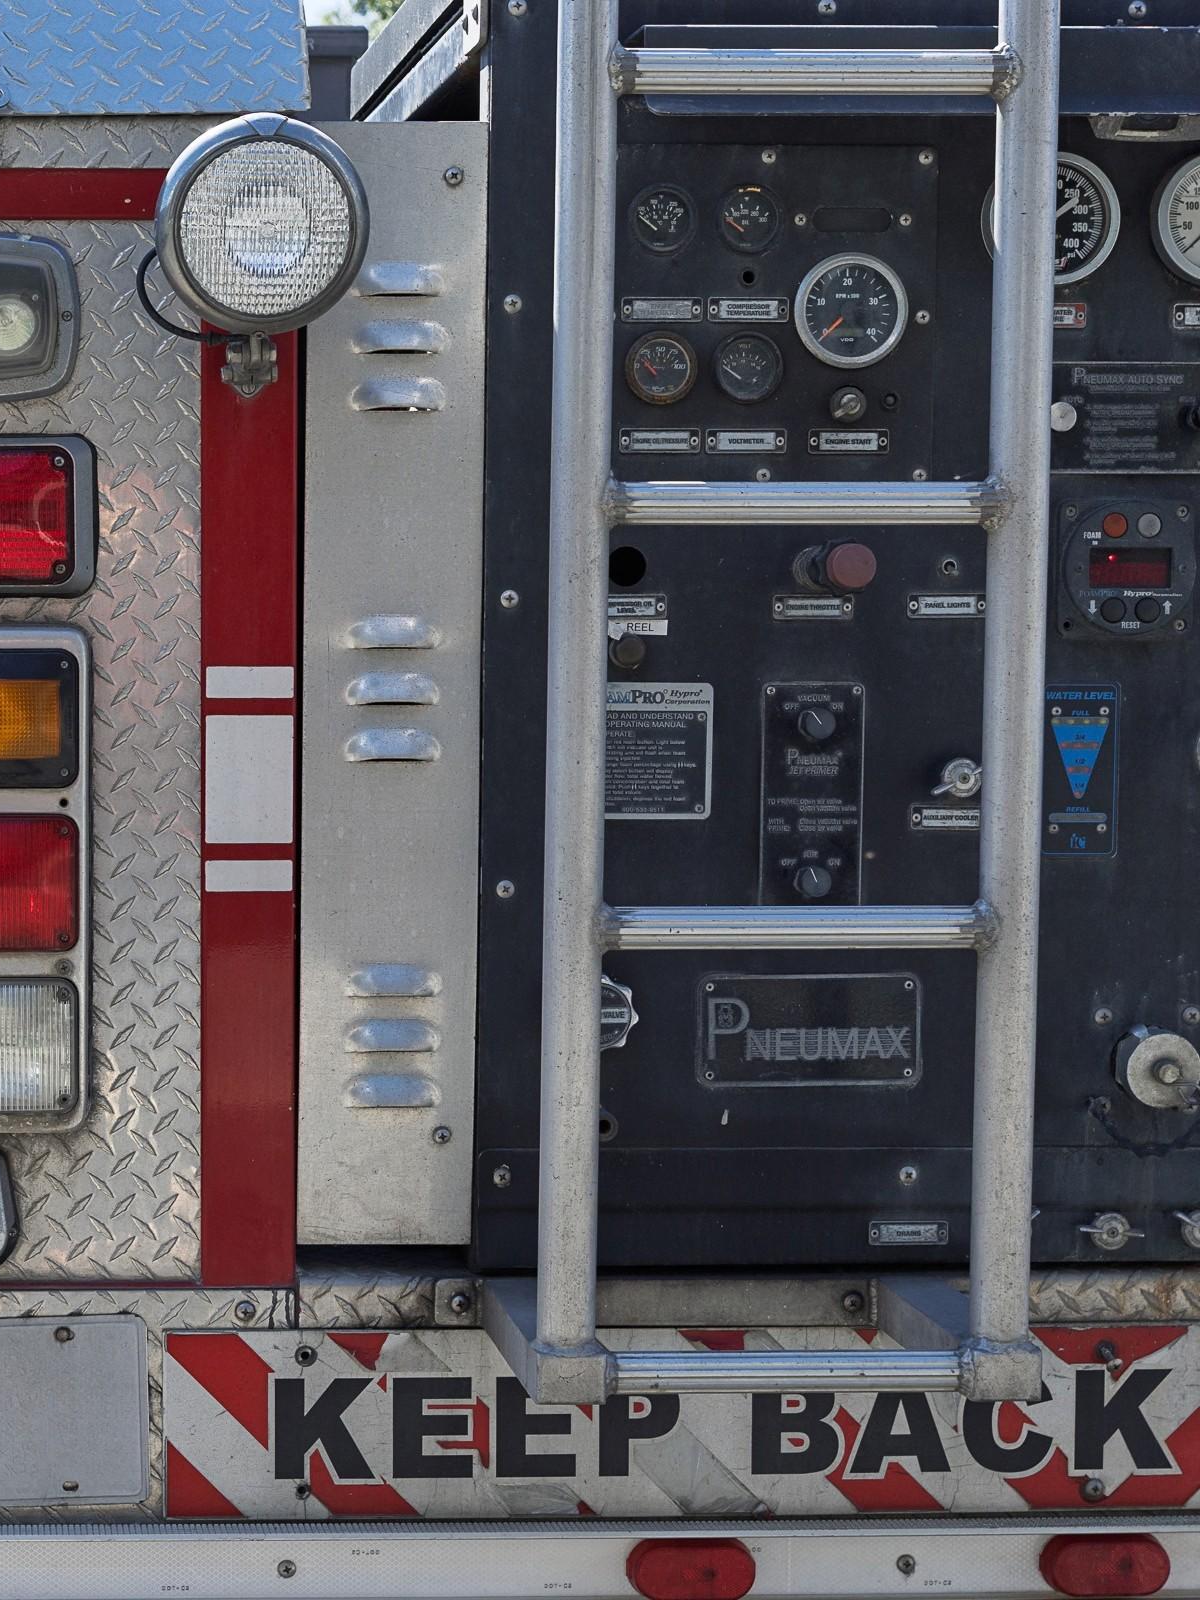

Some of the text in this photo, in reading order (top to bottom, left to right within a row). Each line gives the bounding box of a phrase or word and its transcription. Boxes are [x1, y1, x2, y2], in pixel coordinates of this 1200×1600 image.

[1064, 188, 1080, 198] 250
[1072, 205, 1088, 214] 300
[1185, 201, 1199, 210] 100
[1072, 222, 1088, 232] 350
[1183, 221, 1192, 230] 50
[1063, 238, 1079, 248] 400
[1073, 368, 1184, 385] PNEUMAX AUTO SYNC
[1083, 531, 1101, 539] FOAM
[627, 623, 655, 632] REEL
[1121, 621, 1141, 629] RESET
[1047, 691, 1116, 700] WATER LEVEL
[640, 712, 694, 720] UNDERSTAND
[805, 766, 839, 775] PRIMER
[707, 997, 912, 1061] PNEUMAX
[274, 1369, 1173, 1479] KEEP BACK
